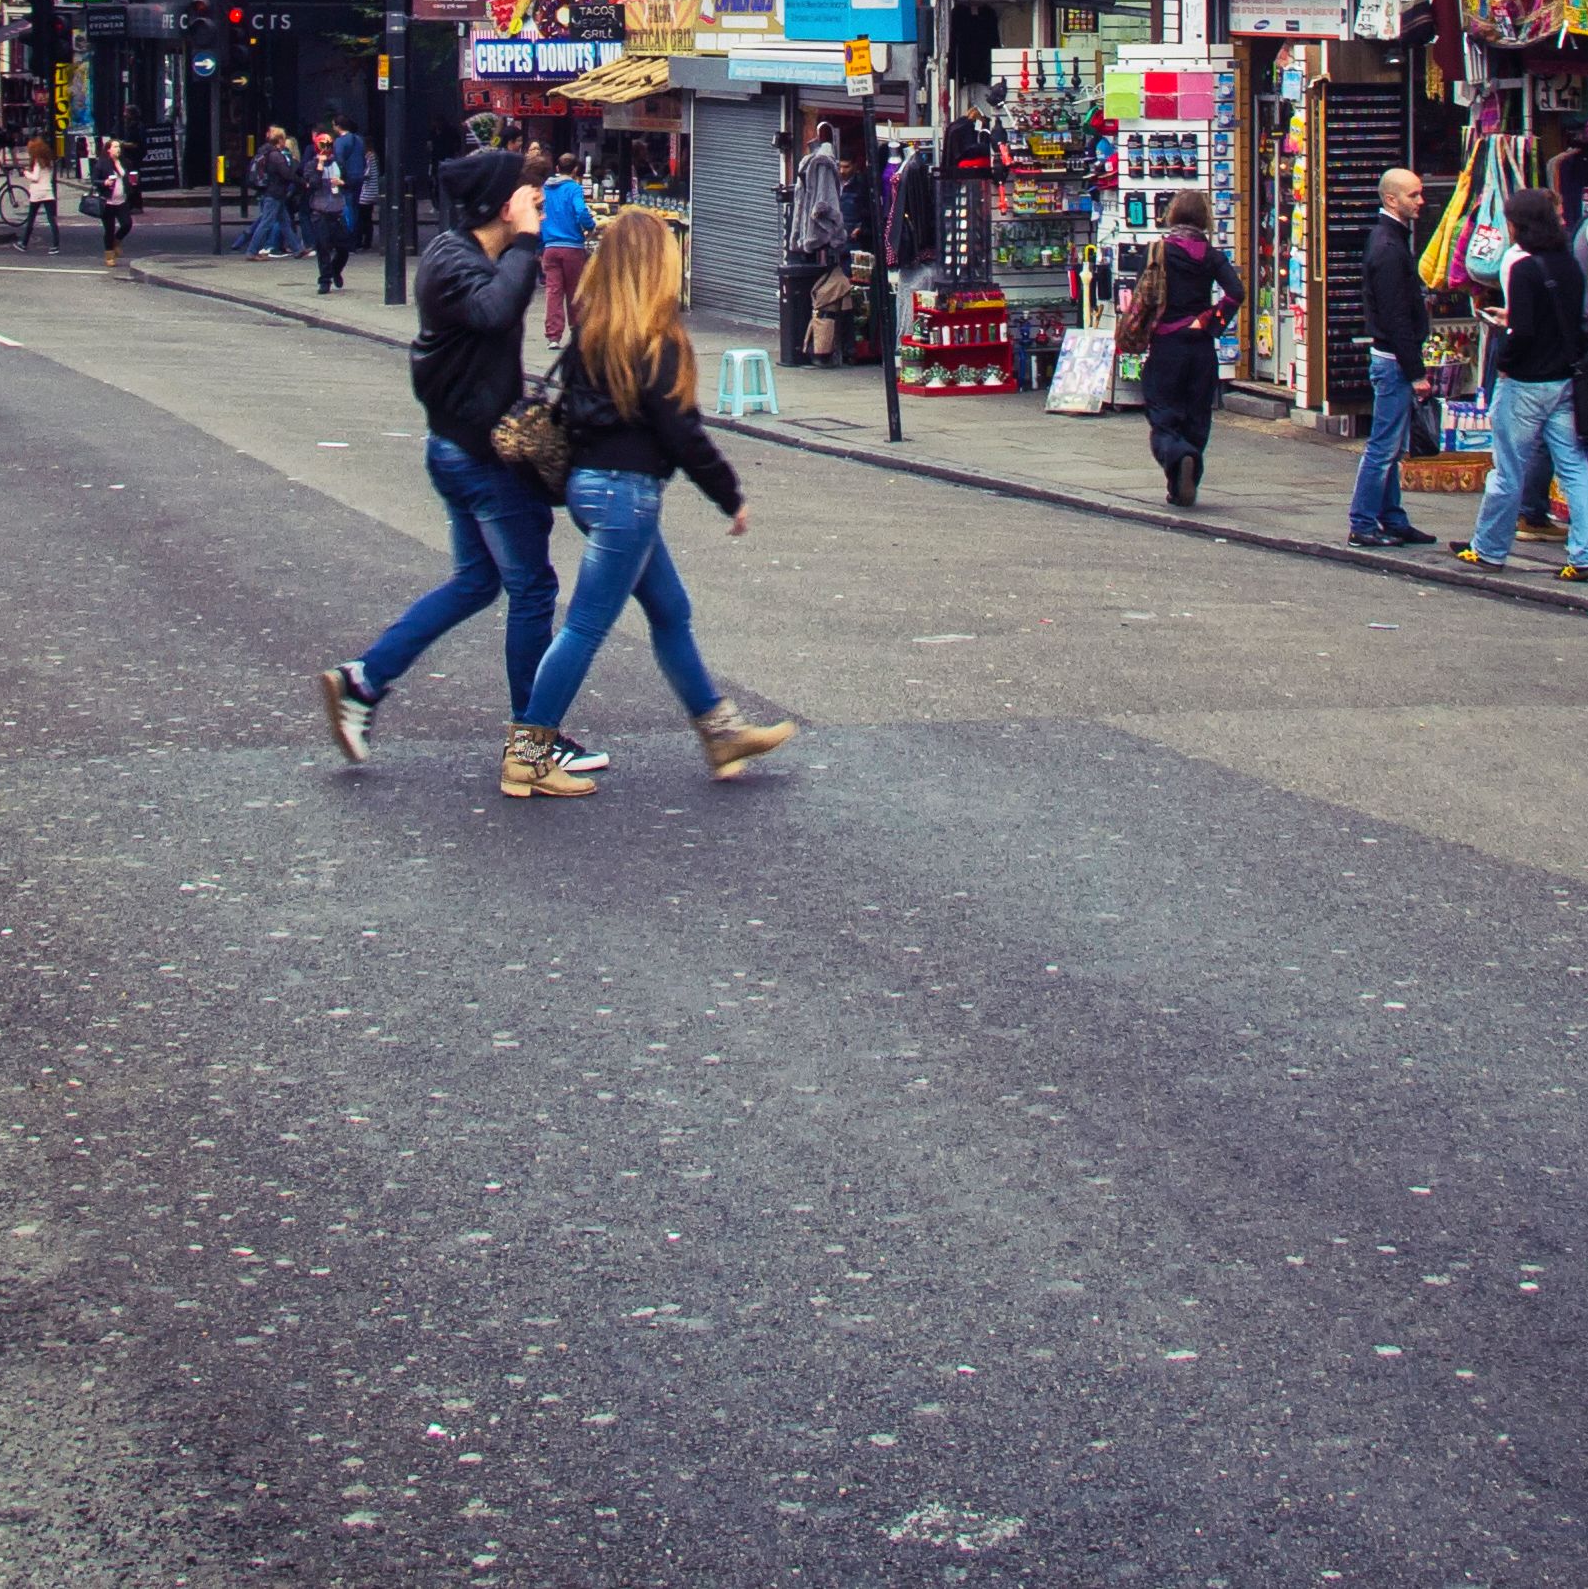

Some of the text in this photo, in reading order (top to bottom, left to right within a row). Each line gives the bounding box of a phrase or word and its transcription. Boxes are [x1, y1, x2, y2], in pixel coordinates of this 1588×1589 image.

[579, 6, 616, 16] TACOS
[580, 29, 614, 40] GRILL
[476, 43, 534, 74] CREPES
[538, 42, 594, 74] DONUTS
